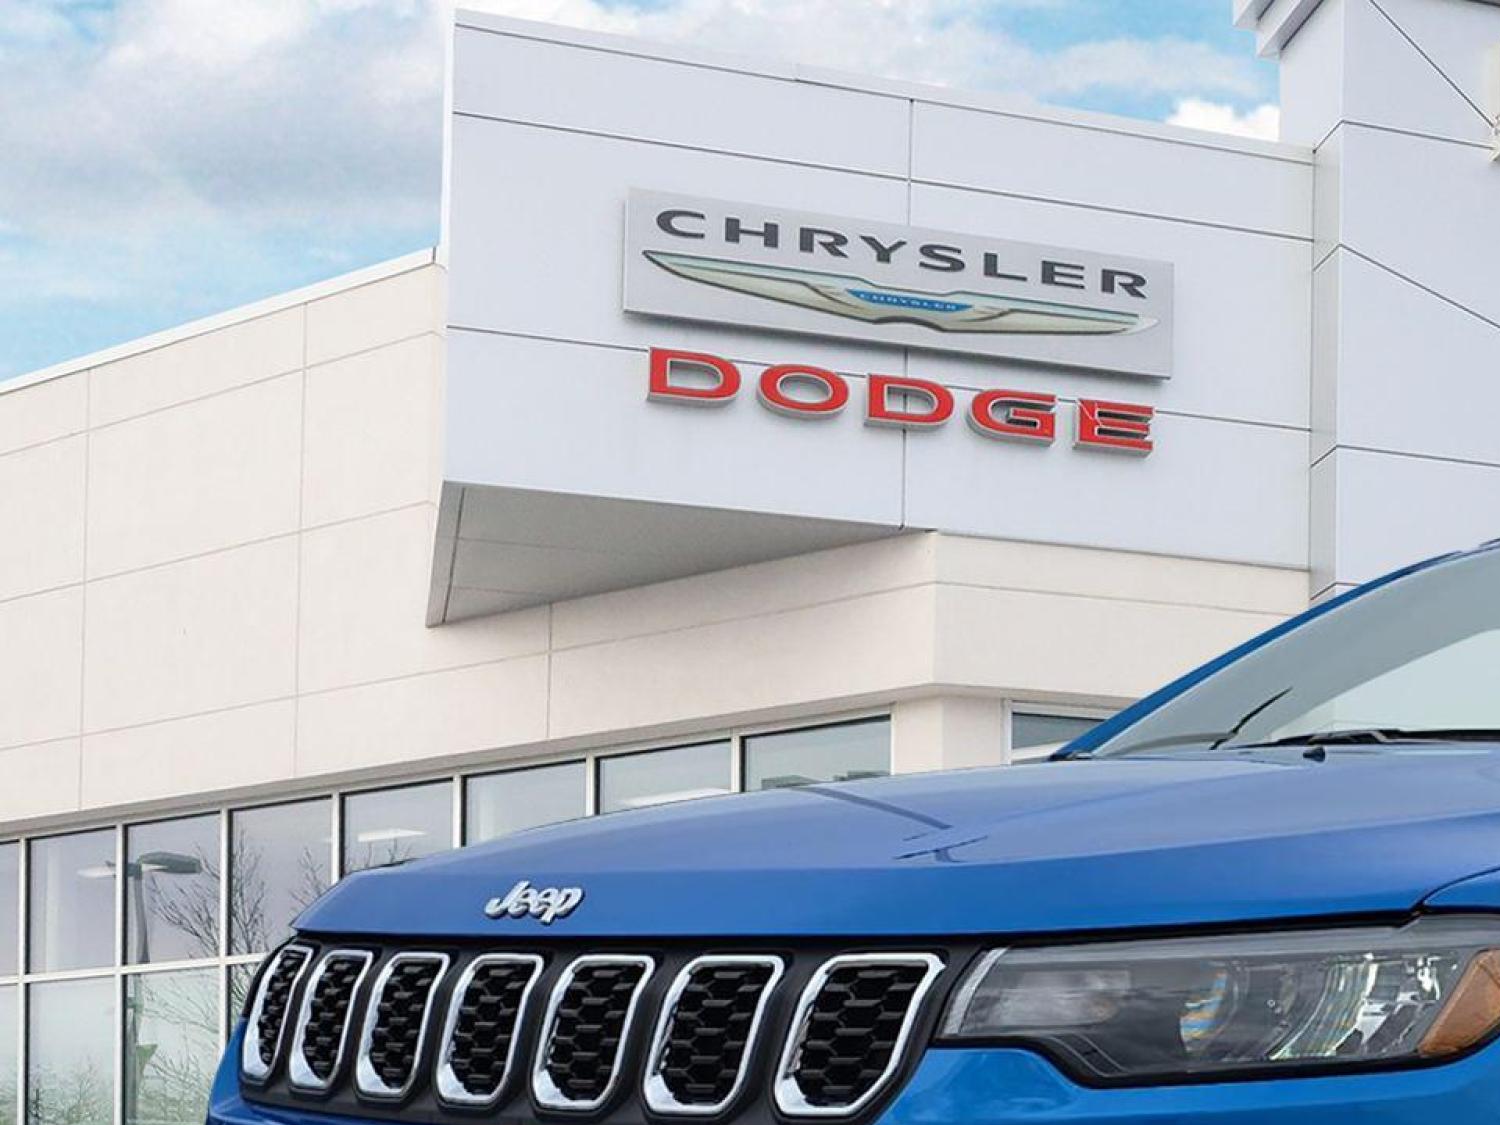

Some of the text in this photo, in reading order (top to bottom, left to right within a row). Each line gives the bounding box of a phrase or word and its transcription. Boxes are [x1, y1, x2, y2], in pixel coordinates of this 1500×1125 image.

[655, 209, 1148, 299] CHRYSLER
[647, 346, 1156, 457] DODGE
[484, 880, 584, 924] Jeep
